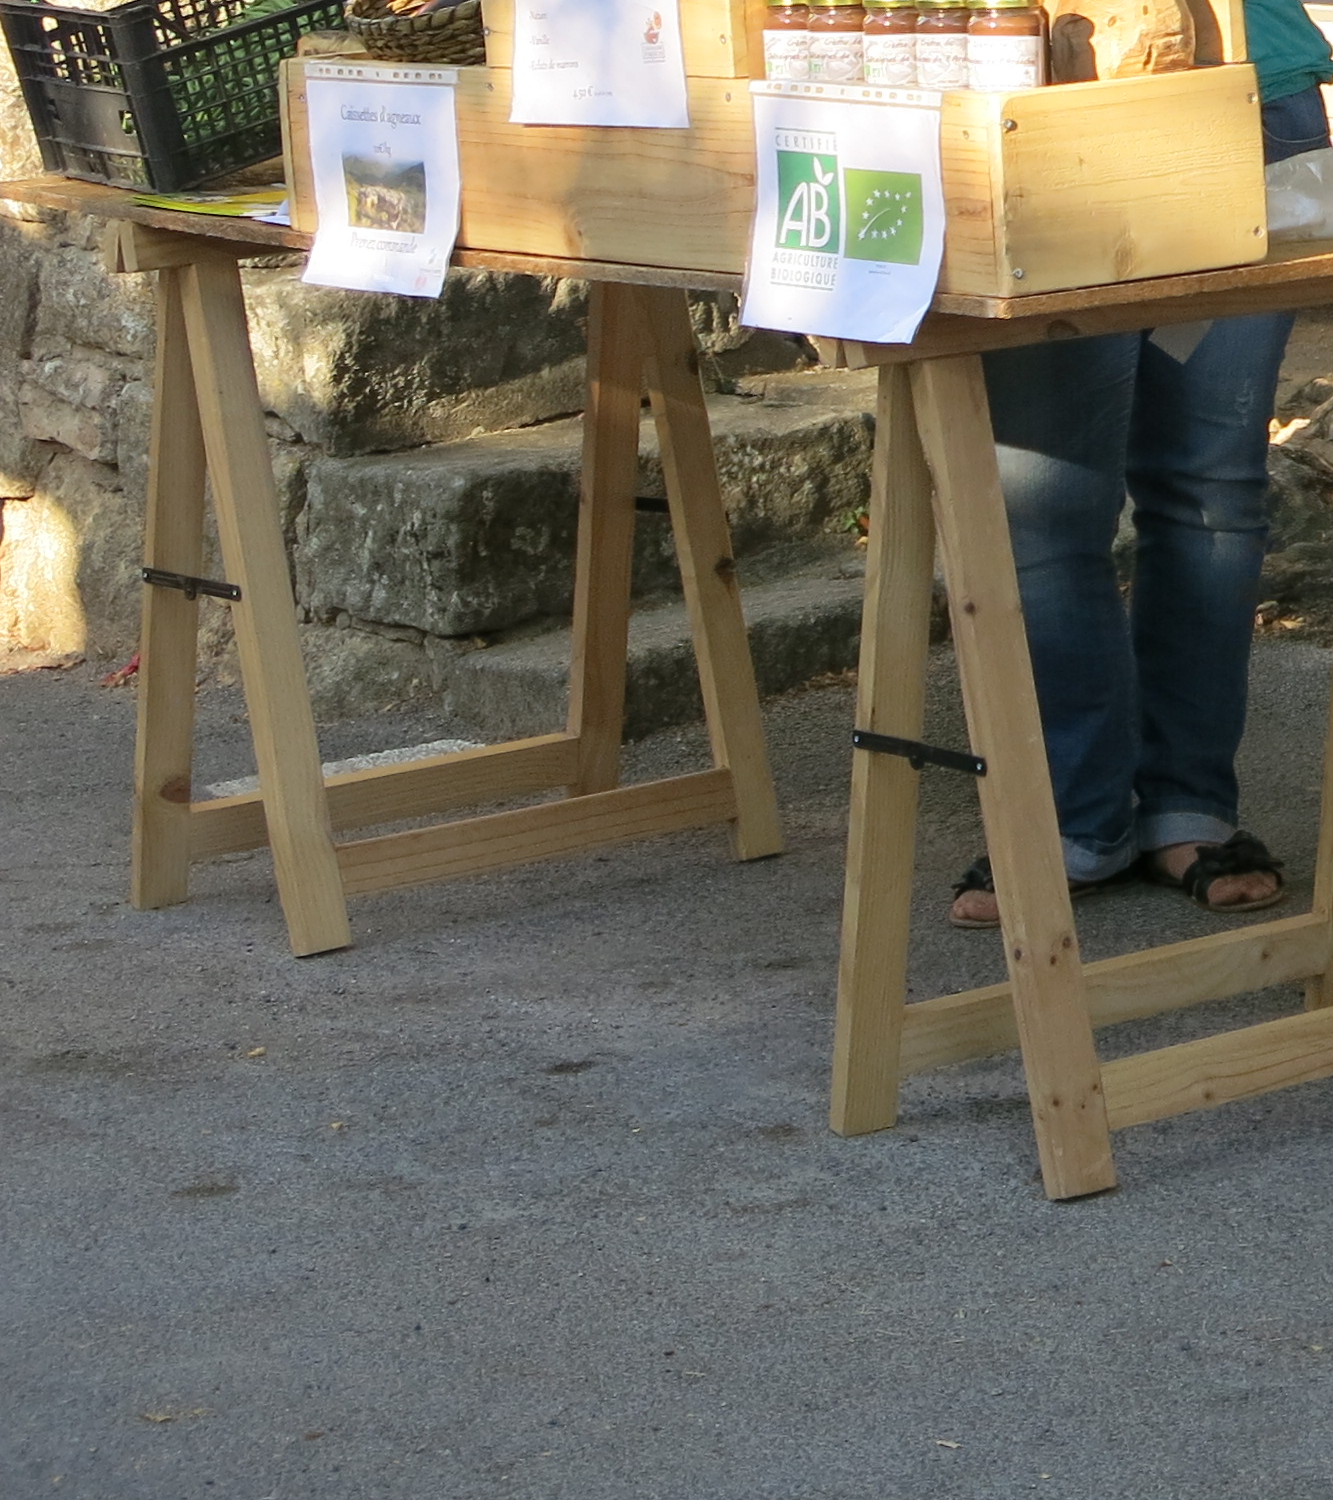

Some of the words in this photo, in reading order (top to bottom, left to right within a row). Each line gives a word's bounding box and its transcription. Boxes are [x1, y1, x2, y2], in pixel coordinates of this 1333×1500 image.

[779, 181, 832, 248] AB
[772, 252, 839, 270] AGRICULTURE
[770, 267, 837, 286] BIOLOGIQUE
